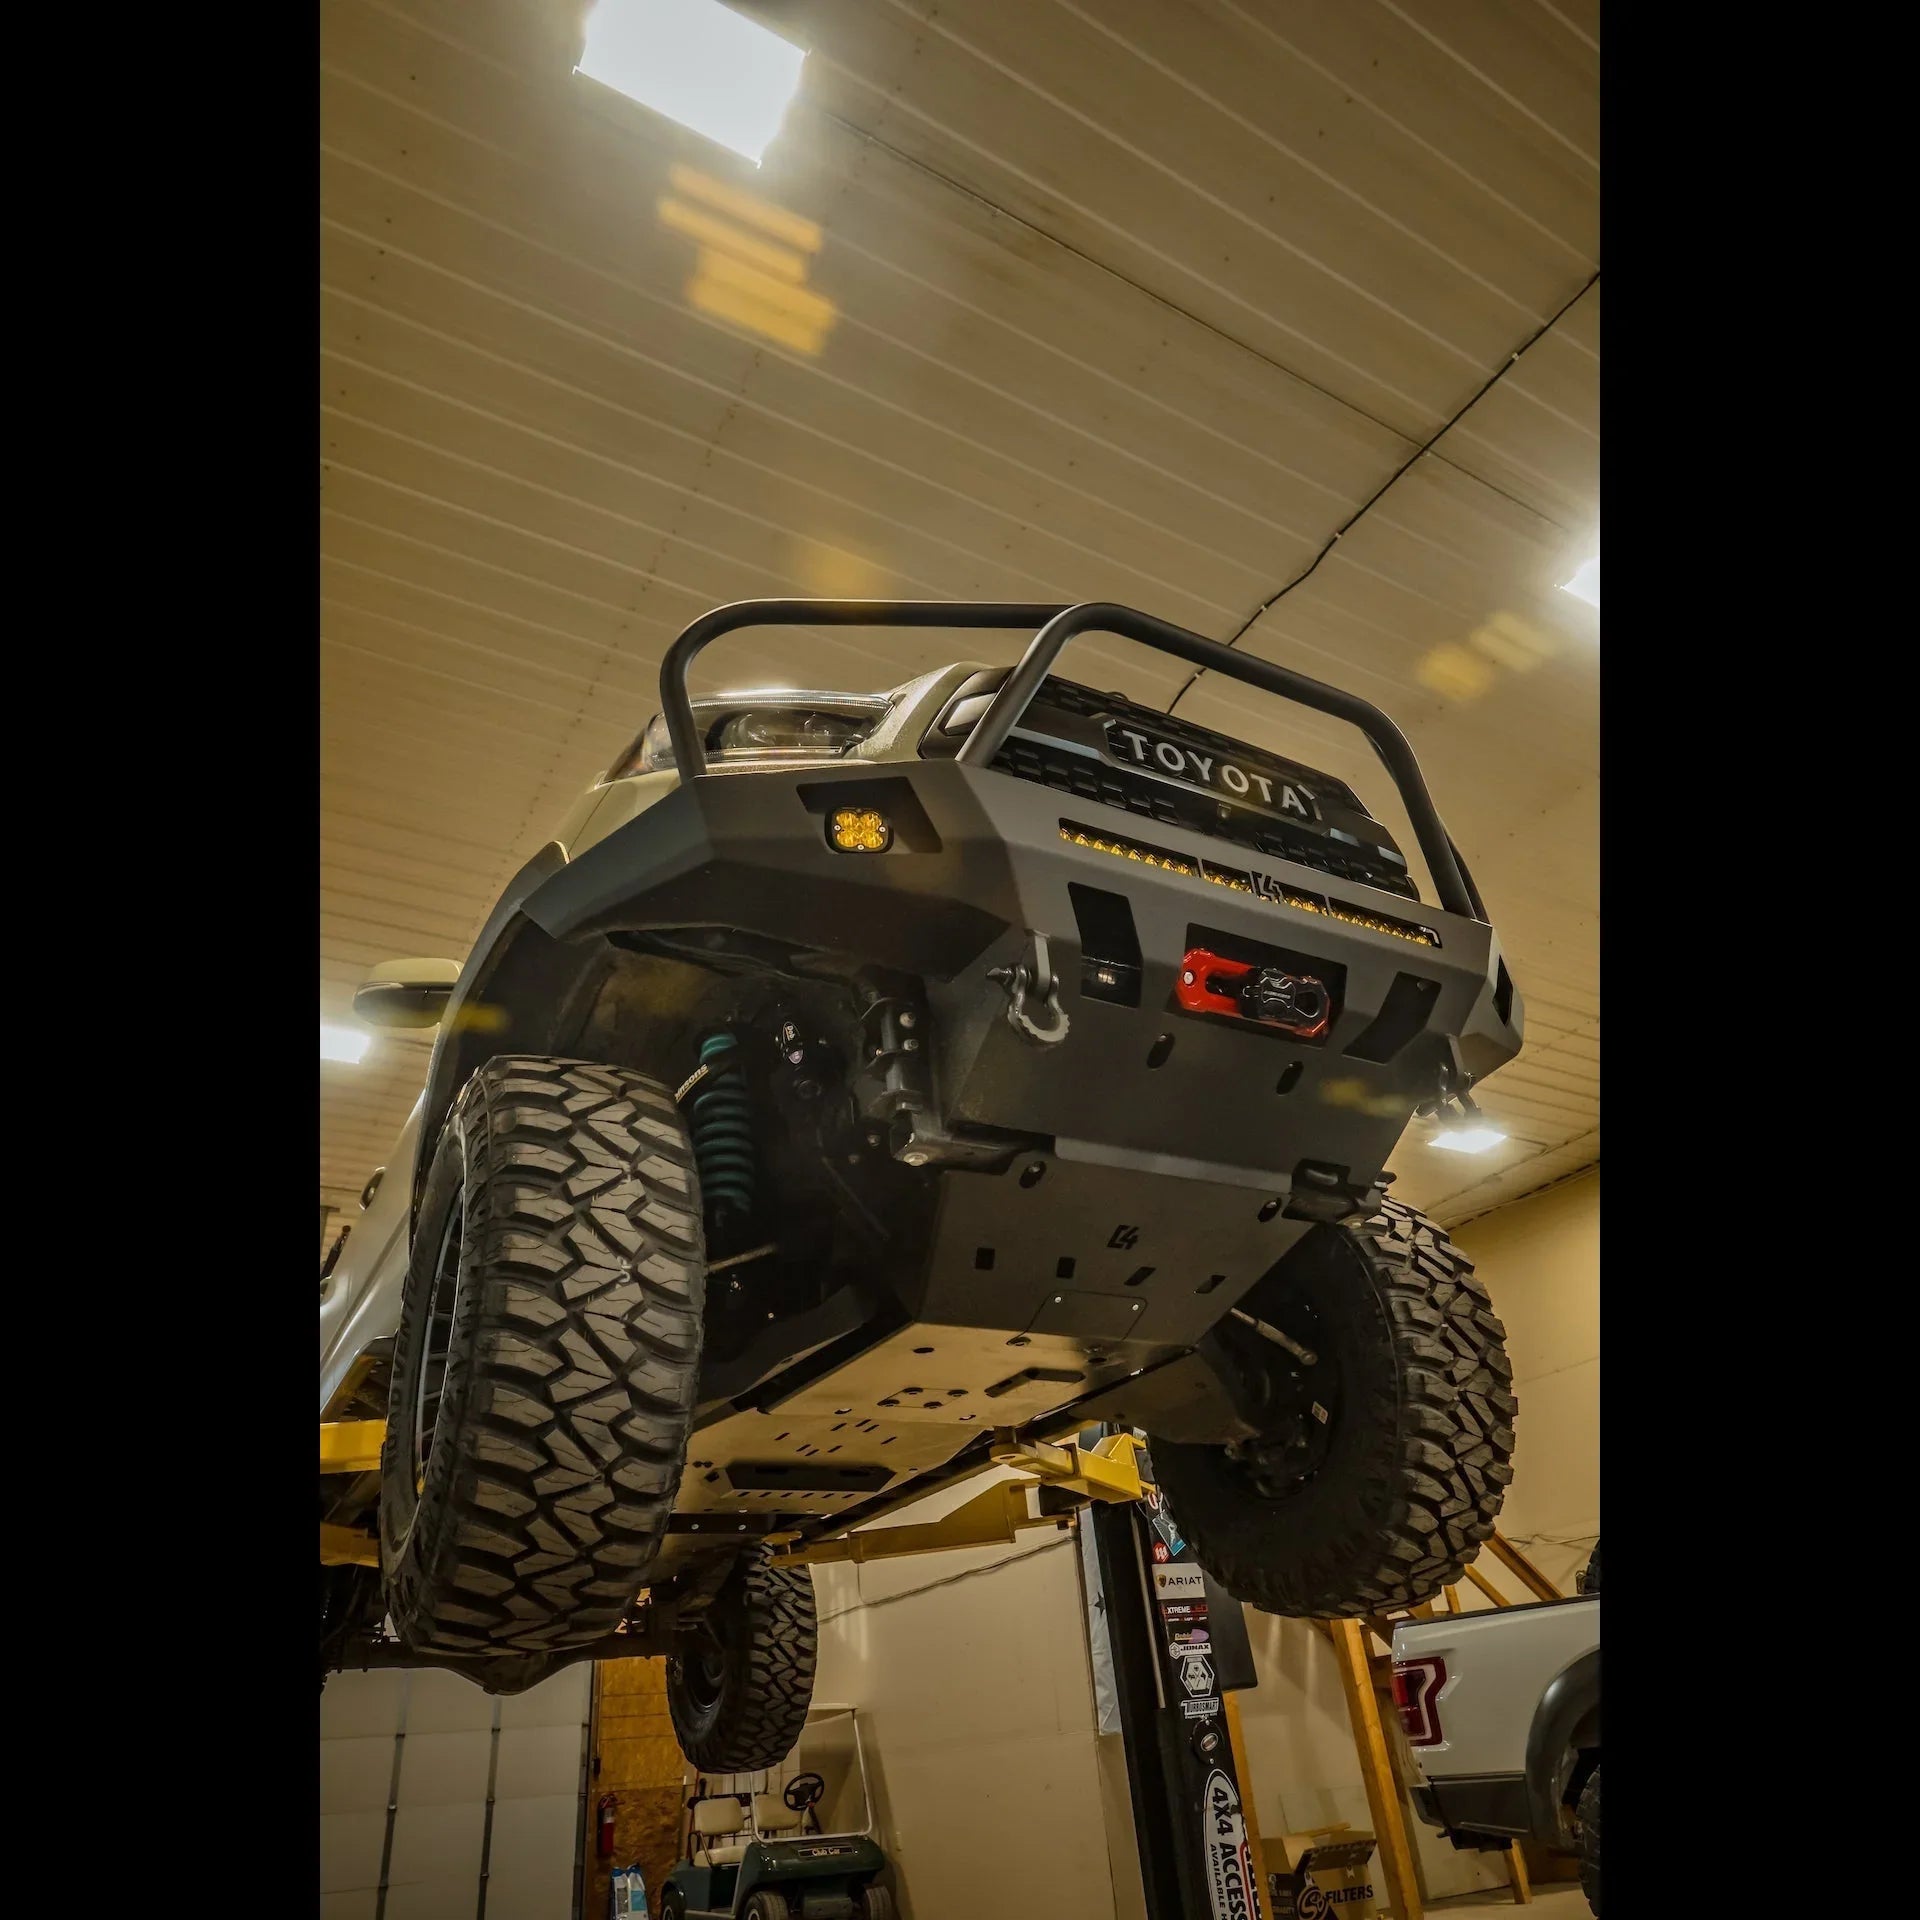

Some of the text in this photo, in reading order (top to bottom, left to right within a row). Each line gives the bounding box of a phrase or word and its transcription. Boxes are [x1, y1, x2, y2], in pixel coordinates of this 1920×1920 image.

[1122, 729, 1308, 817] TOYOTA
[1168, 1576, 1202, 1586] ARIAT
[1212, 1787, 1234, 1836] 4X4
[1210, 1844, 1226, 1909] AVAILABLE
[1324, 1884, 1374, 1904] FILTERS
